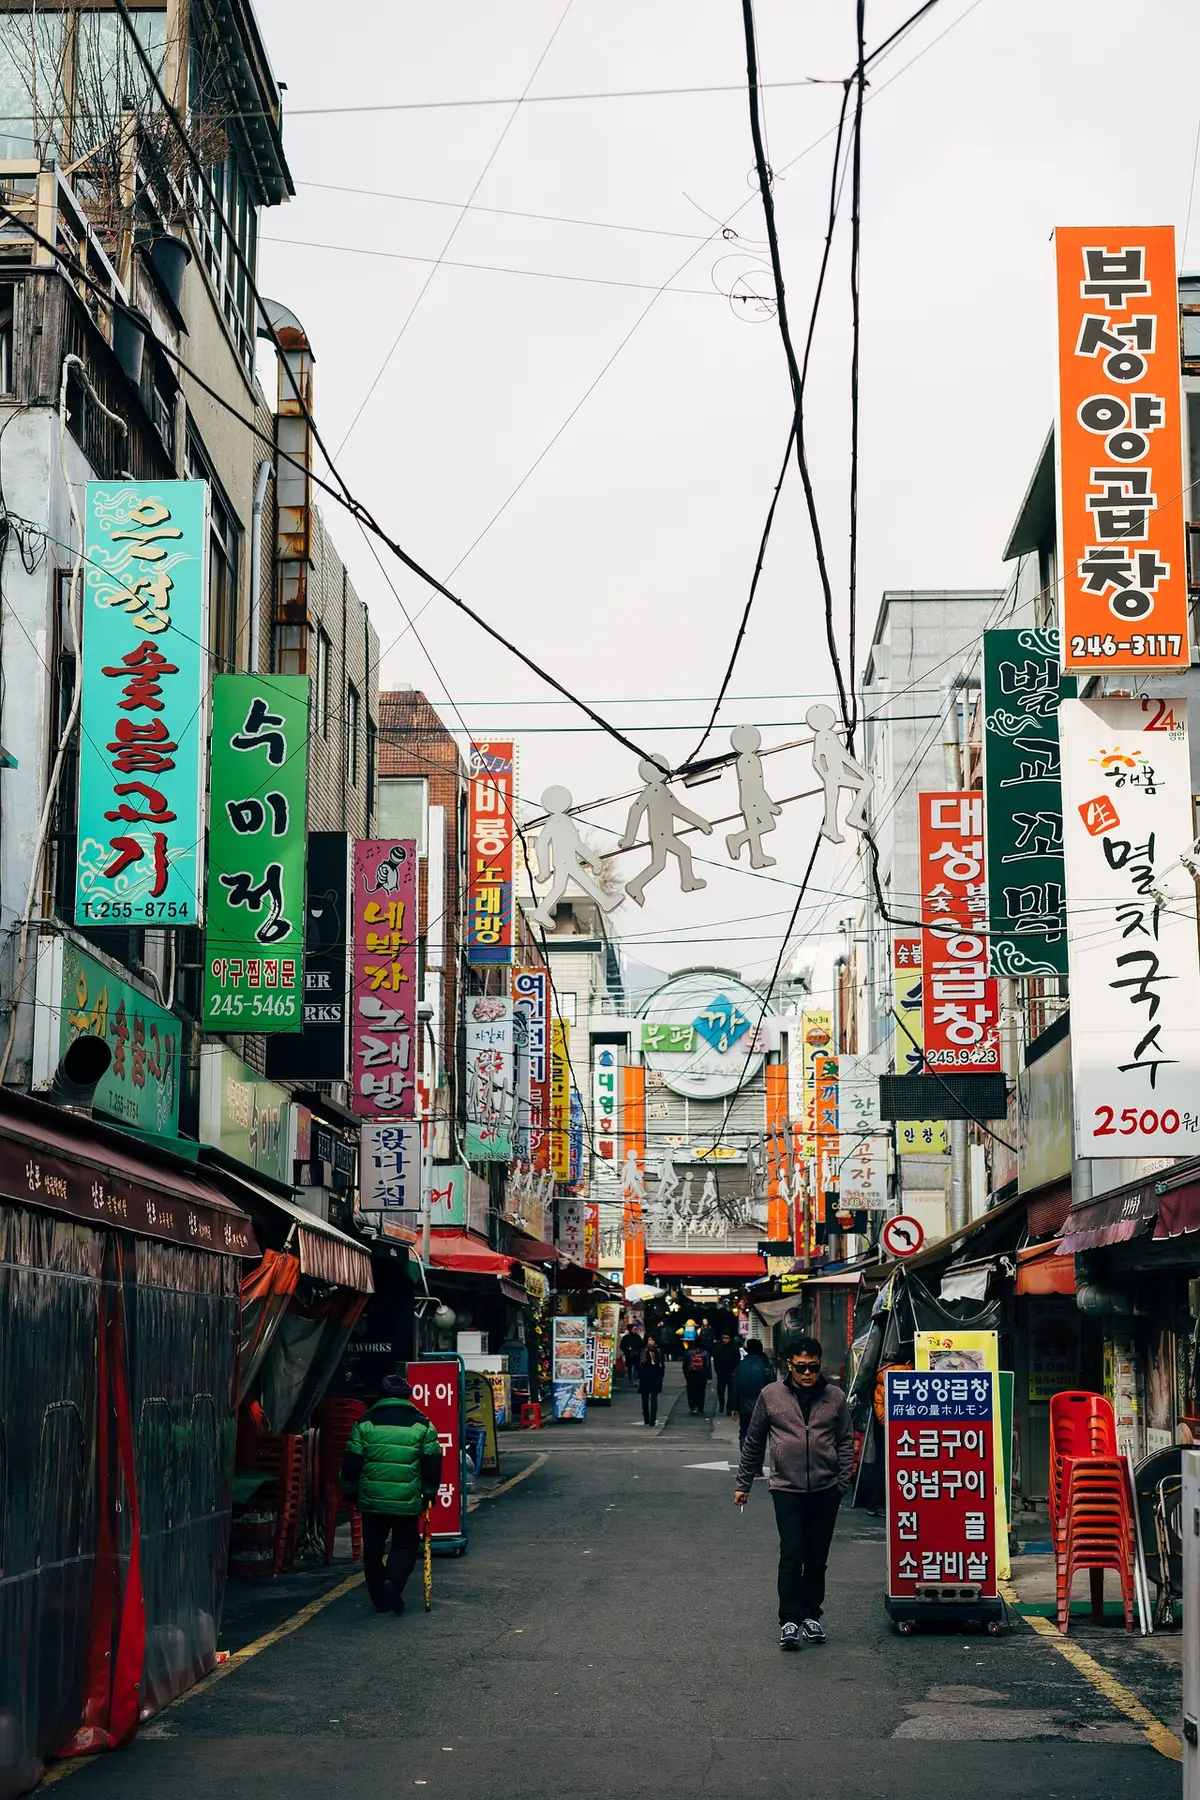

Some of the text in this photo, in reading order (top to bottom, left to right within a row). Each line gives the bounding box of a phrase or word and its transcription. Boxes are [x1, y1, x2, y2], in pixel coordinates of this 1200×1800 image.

[1075, 246, 1171, 622] 부성양곱창
[1071, 633, 1183, 657] 246-3117
[1142, 699, 1184, 731] 24시
[1105, 765, 1165, 795] 해봄
[219, 696, 290, 944] 수미정
[1087, 802, 1117, 833] 生
[81, 902, 189, 919] T.255-8754
[211, 958, 296, 988] 아구찜전문
[1102, 832, 1180, 1090] 멸치국수
[209, 994, 296, 1017] 245-5465
[475, 1028, 505, 1044] 자갈치
[355, 1342, 391, 1353] WORKS
[892, 1378, 989, 1402] 부성양곱창
[896, 1430, 985, 1459] 소금구이
[896, 1470, 985, 1500] 양념구이
[898, 1551, 988, 1581] 소갈비살
